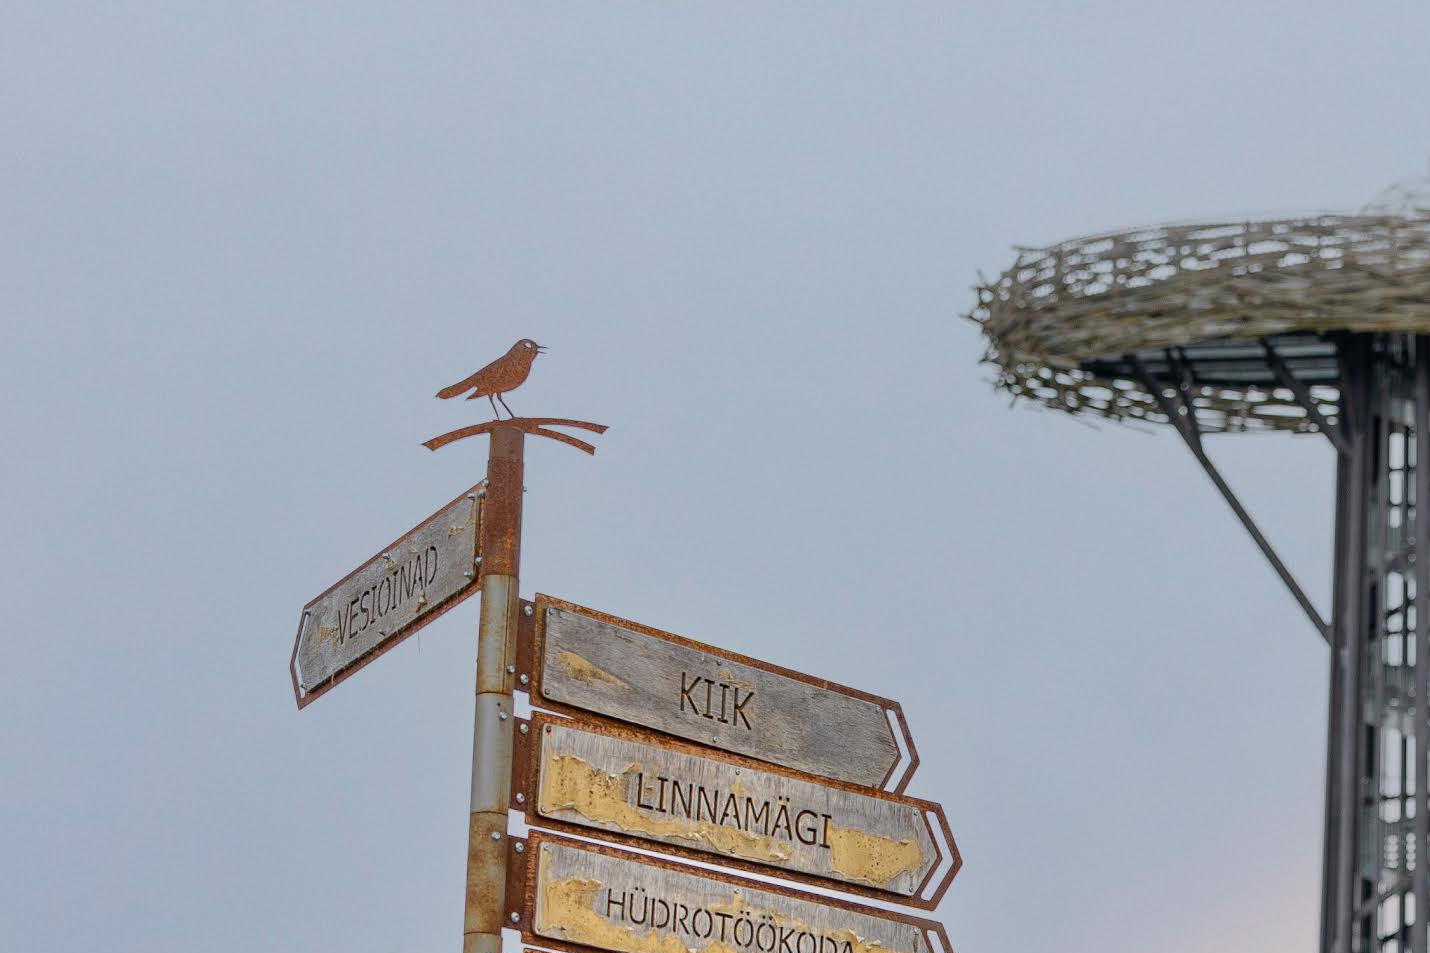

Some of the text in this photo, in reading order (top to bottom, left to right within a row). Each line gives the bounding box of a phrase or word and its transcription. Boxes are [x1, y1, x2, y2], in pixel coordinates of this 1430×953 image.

[337, 545, 438, 645] VESIOINAD
[680, 671, 755, 730] KIIK
[636, 773, 832, 848] LINNAMÄGI
